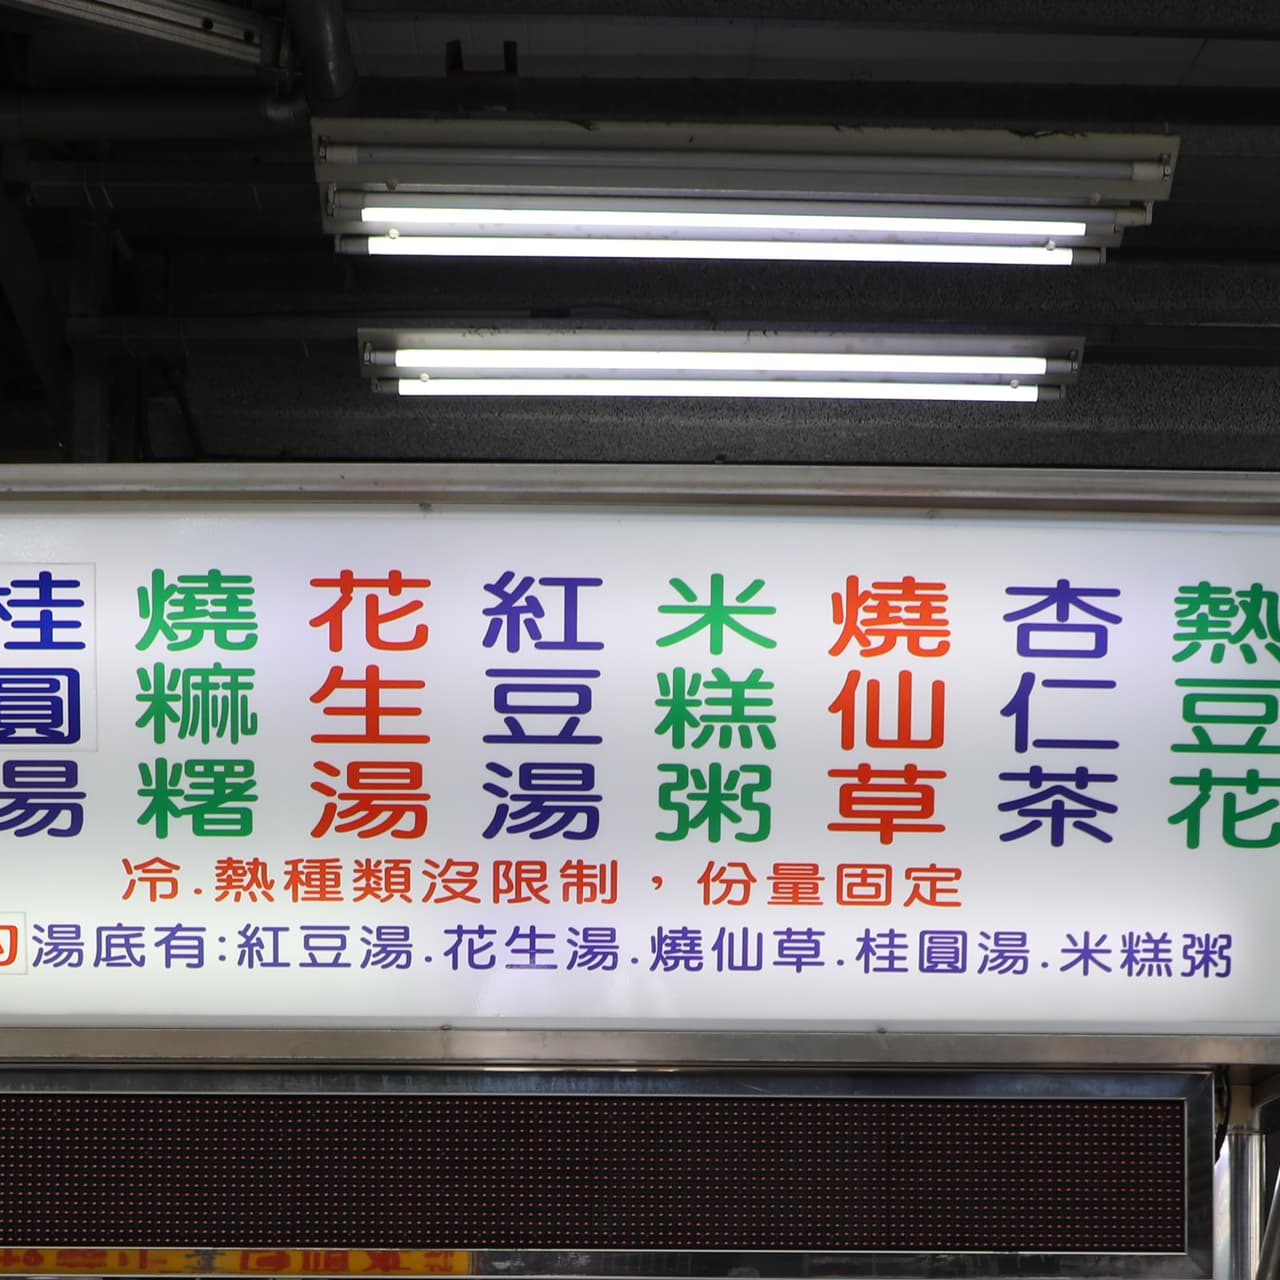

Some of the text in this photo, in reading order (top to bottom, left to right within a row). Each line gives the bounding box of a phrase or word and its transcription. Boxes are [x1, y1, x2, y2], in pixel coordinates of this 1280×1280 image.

[309, 569, 432, 840] 花生湯
[482, 570, 604, 840] 紅豆湯
[655, 573, 777, 843] 米糕粥
[827, 574, 951, 846] 燒仙草
[998, 578, 1122, 847] 杏仁茶
